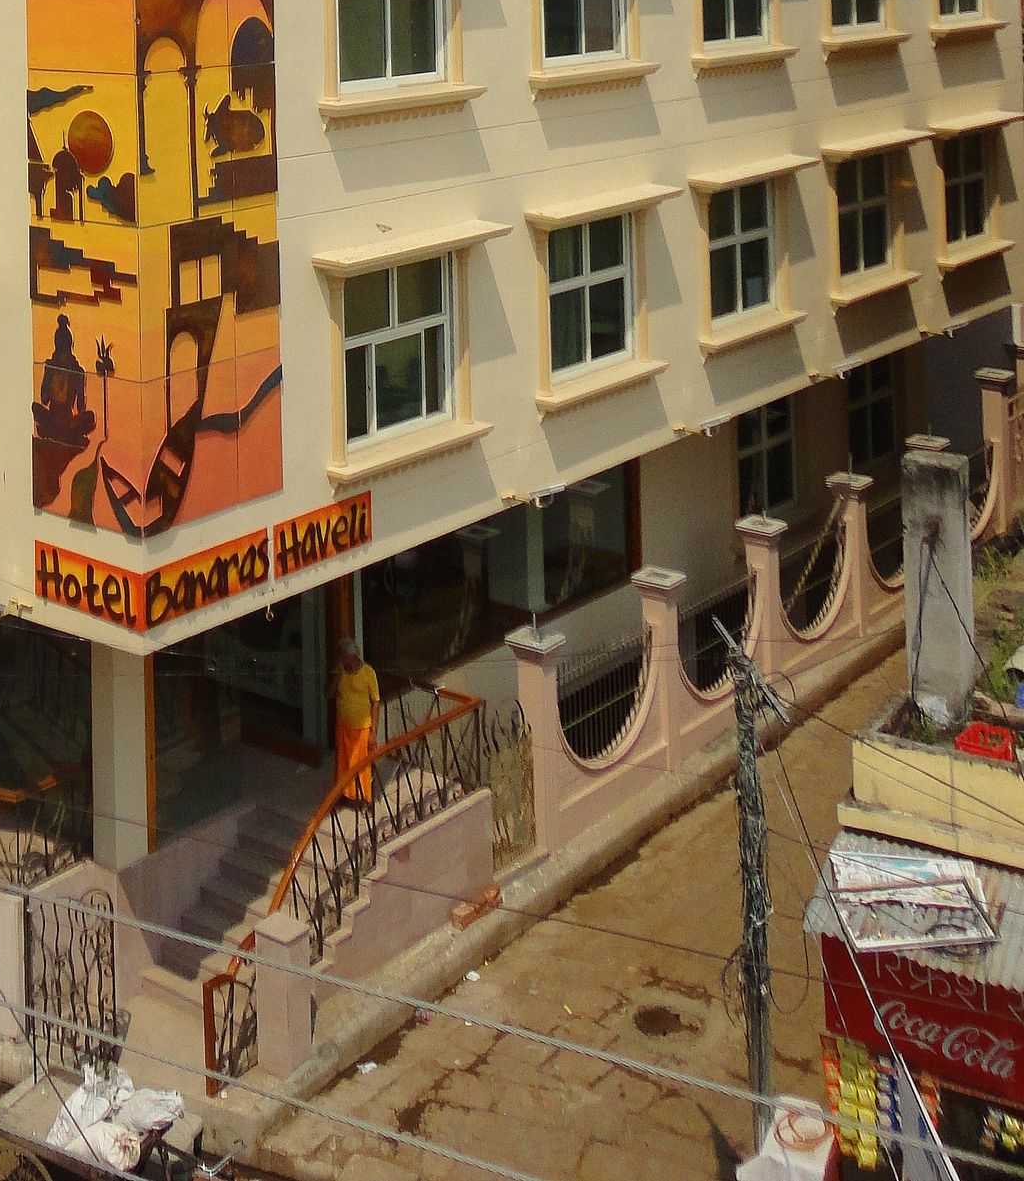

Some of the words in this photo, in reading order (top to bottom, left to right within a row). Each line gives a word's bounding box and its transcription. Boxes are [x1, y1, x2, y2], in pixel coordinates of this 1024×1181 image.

[36, 548, 137, 625] Hotel
[144, 537, 271, 627] Banaras
[276, 502, 367, 576] Haveli
